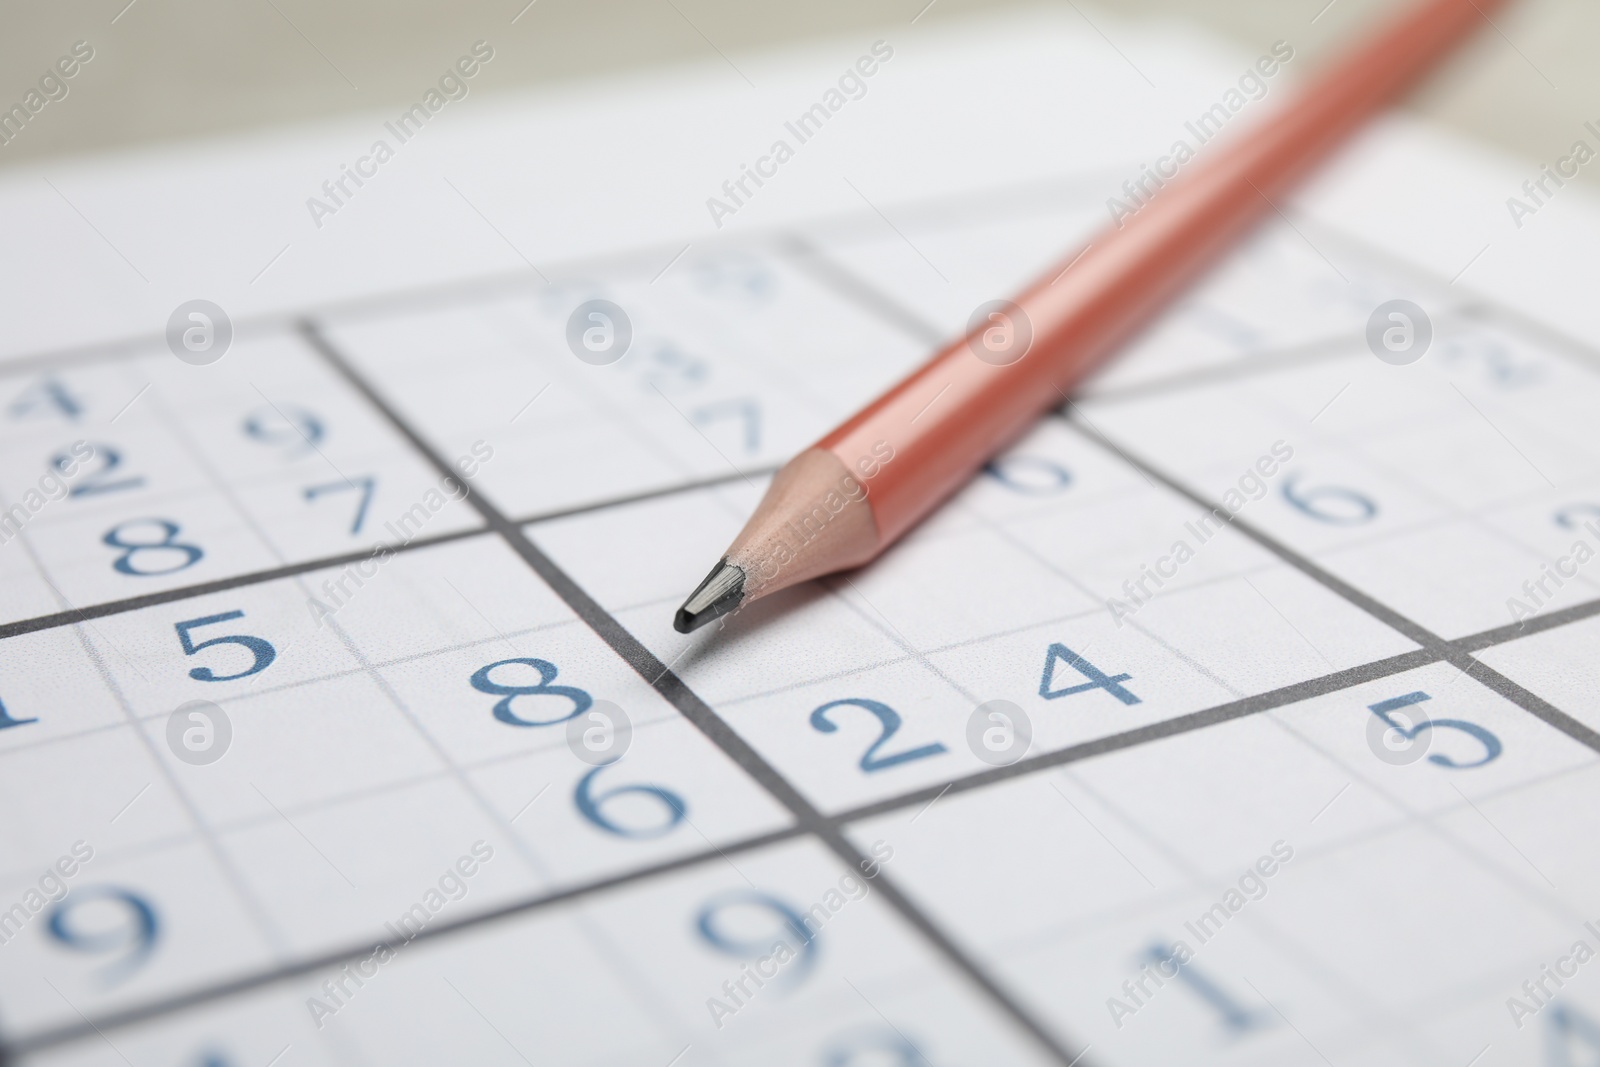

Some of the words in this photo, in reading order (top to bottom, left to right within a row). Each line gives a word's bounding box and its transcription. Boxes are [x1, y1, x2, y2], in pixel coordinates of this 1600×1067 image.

[241, 402, 328, 460] 9
[50, 442, 147, 498] 2
[1281, 472, 1378, 526] 6
[301, 473, 376, 538] 7
[102, 516, 205, 577] 8
[174, 610, 277, 682] 5
[1038, 643, 1143, 707] 4
[470, 658, 593, 727] 8
[810, 697, 949, 774] 2
[1366, 691, 1502, 769] 5
[572, 757, 689, 840] 6
[42, 884, 162, 992] 9
[694, 888, 822, 1000] 9
